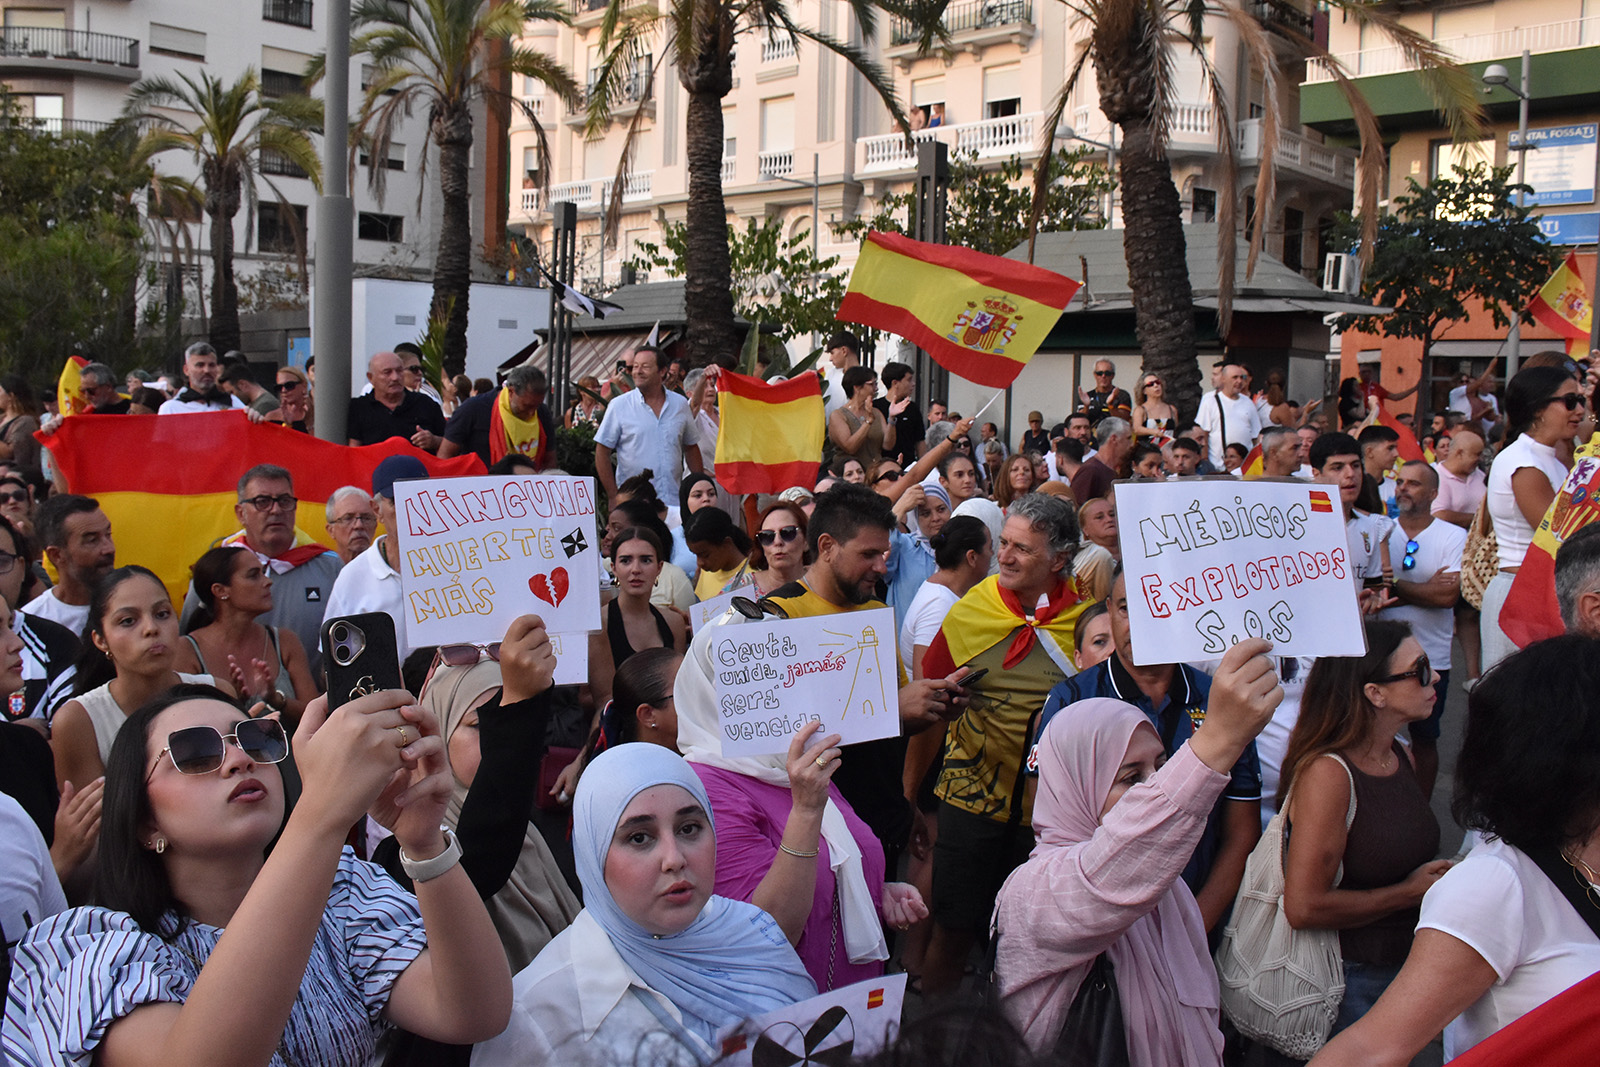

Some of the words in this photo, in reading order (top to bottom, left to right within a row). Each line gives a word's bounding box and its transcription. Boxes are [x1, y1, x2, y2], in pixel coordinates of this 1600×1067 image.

[1510, 131, 1548, 142] DNTAL
[1550, 126, 1595, 138] FOSSATI
[407, 528, 555, 578] MUERTE
[409, 574, 495, 624] MÁS
[1141, 548, 1345, 618] EXPLOTADOS
[718, 632, 798, 667] Ceuta
[783, 651, 847, 688] jamás
[721, 685, 780, 718] será
